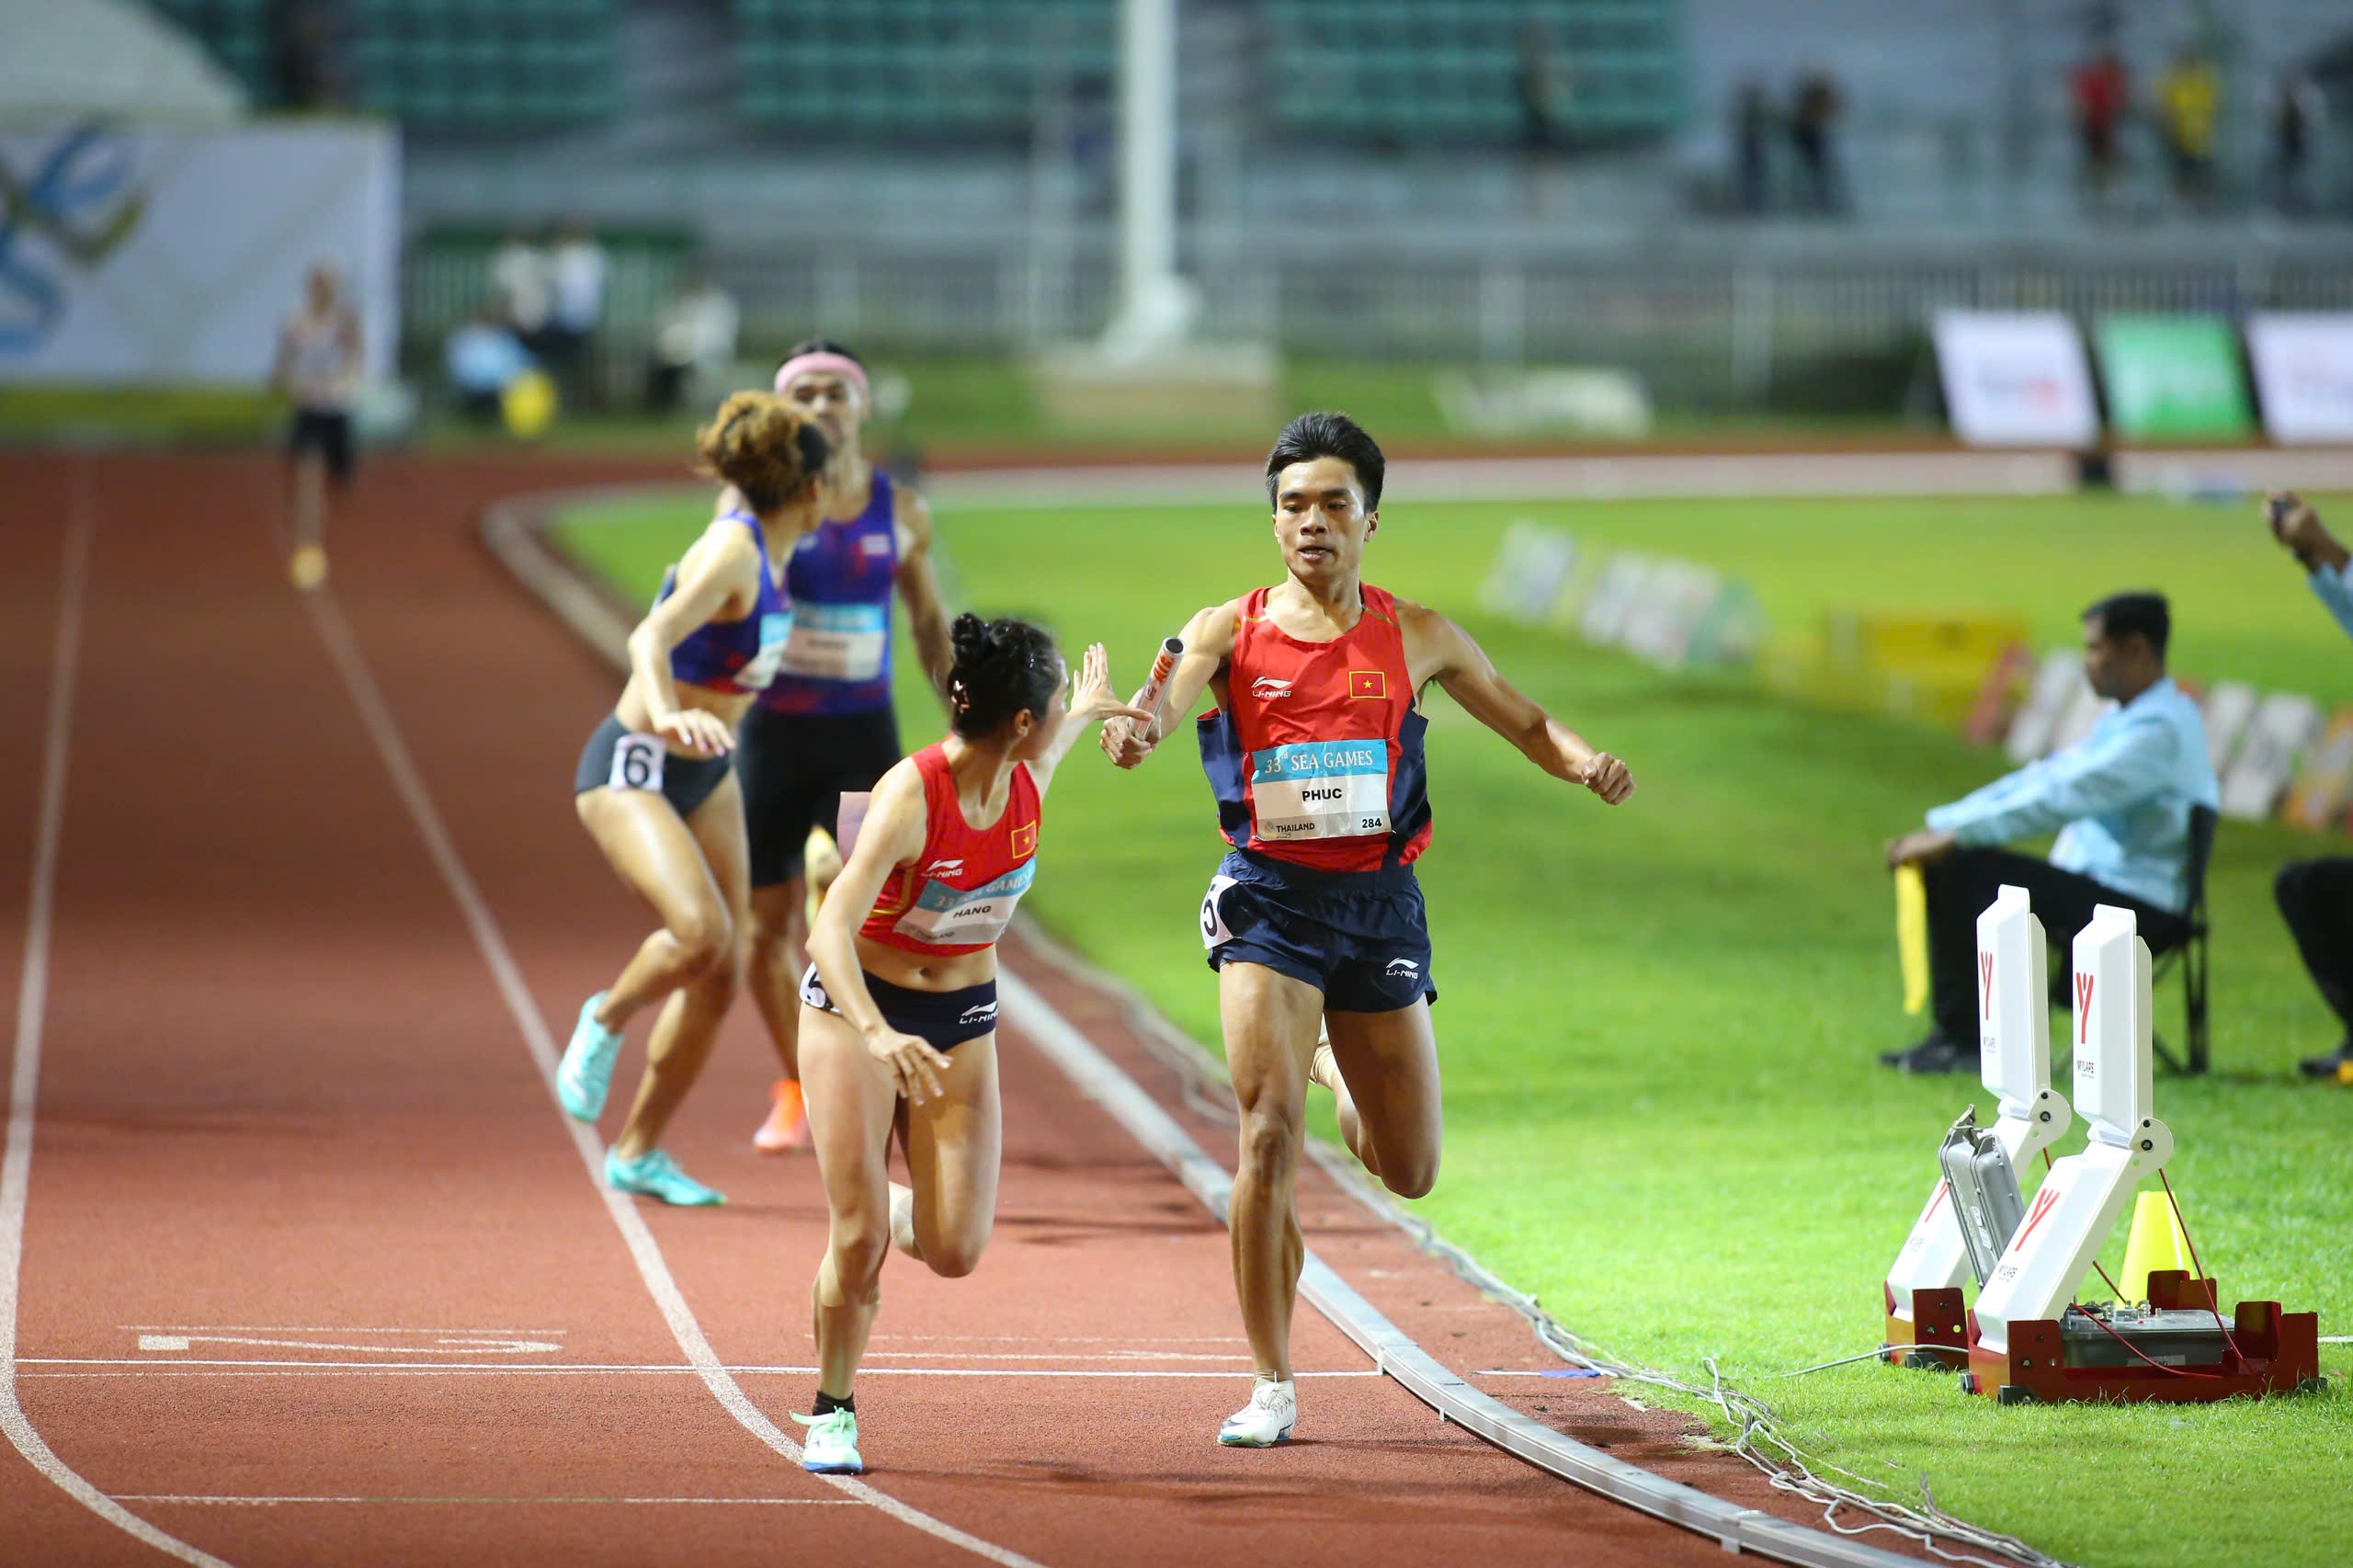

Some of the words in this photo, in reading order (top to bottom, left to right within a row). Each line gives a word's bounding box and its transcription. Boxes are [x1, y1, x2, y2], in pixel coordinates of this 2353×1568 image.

[624, 744, 652, 789] 6
[1290, 754, 1320, 771] SEA
[1324, 750, 1373, 768] GAMES
[1302, 788, 1343, 801] PHUC
[1276, 823, 1315, 833] THAILAND
[1361, 817, 1382, 829] 284
[952, 904, 992, 918] HANG
[1386, 970, 1419, 980] LI-NING
[959, 1010, 998, 1025] LI-NIN
